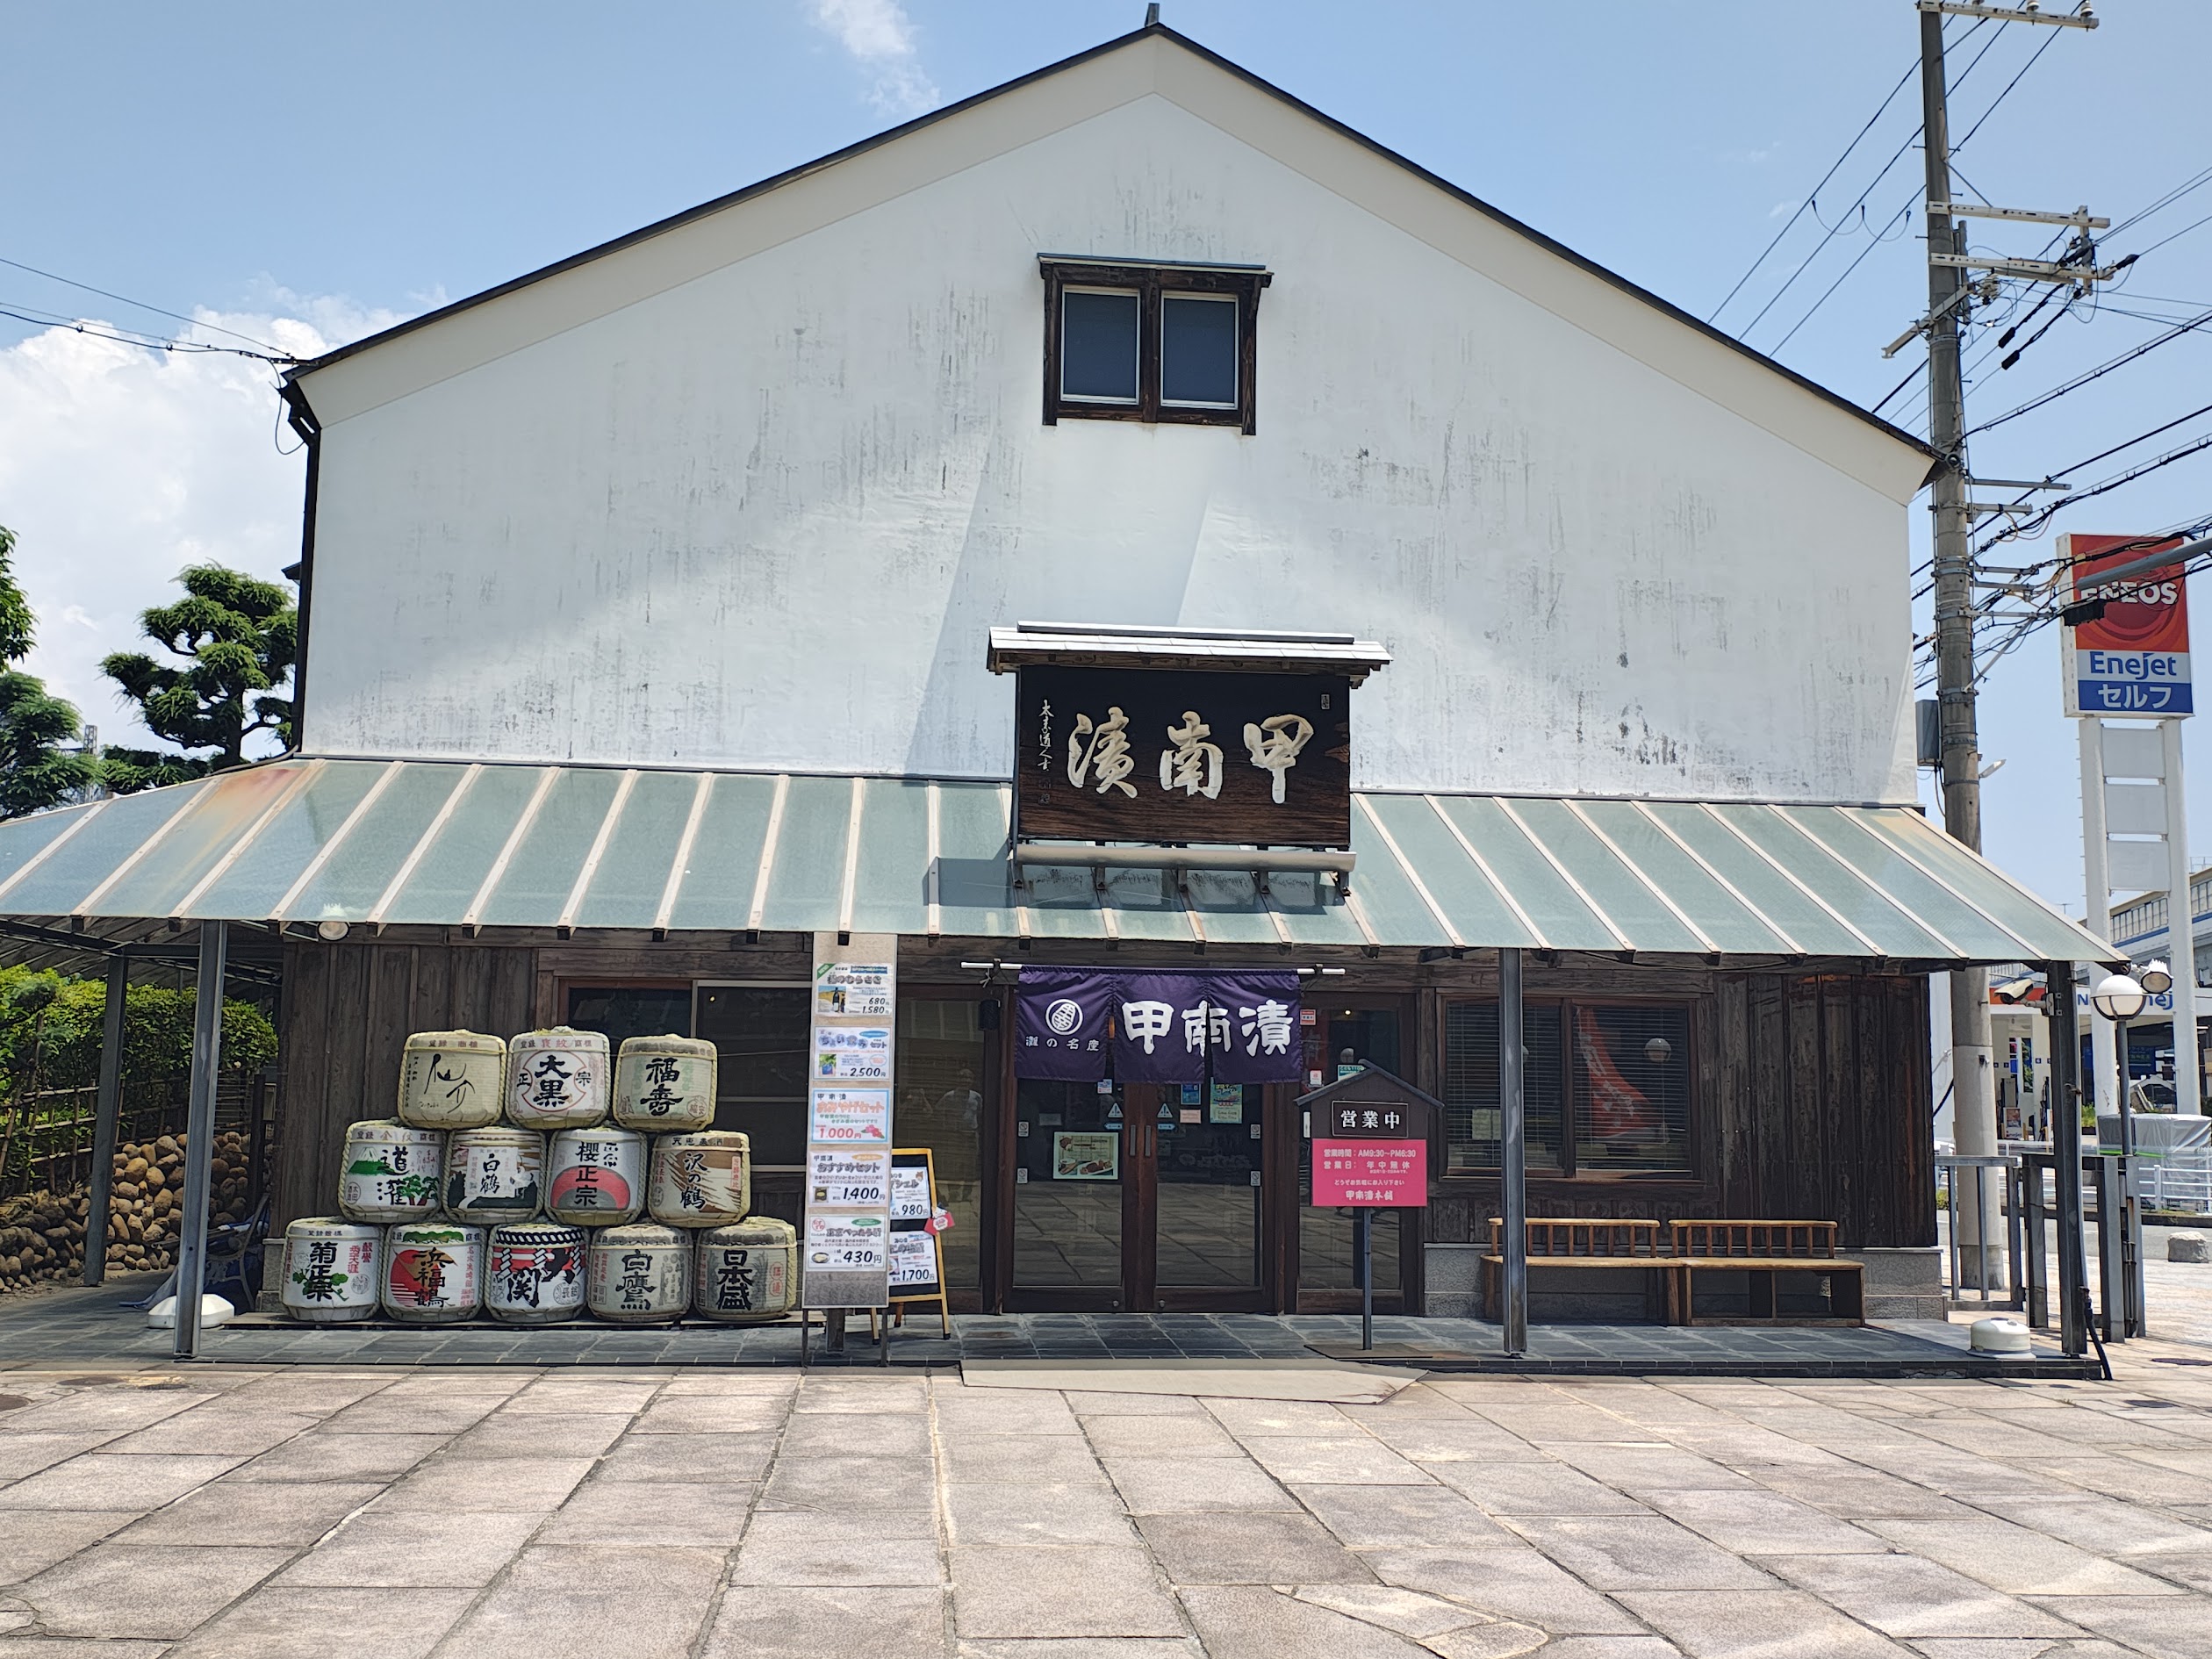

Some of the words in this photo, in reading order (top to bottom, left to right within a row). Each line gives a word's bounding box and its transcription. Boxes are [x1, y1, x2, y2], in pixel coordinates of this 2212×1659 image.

[2081, 580, 2178, 605] ENEOS
[2098, 684, 2172, 708] セルフ
[1122, 1000, 1294, 1057] 甲南漬
[1340, 1110, 1400, 1130] 営業中
[480, 1153, 500, 1194] 白鶴
[680, 1153, 707, 1210] 沢の鶴
[306, 1241, 339, 1303] 菊正宗
[615, 1249, 657, 1311] 白鷹
[716, 1249, 753, 1311] 日本盛
